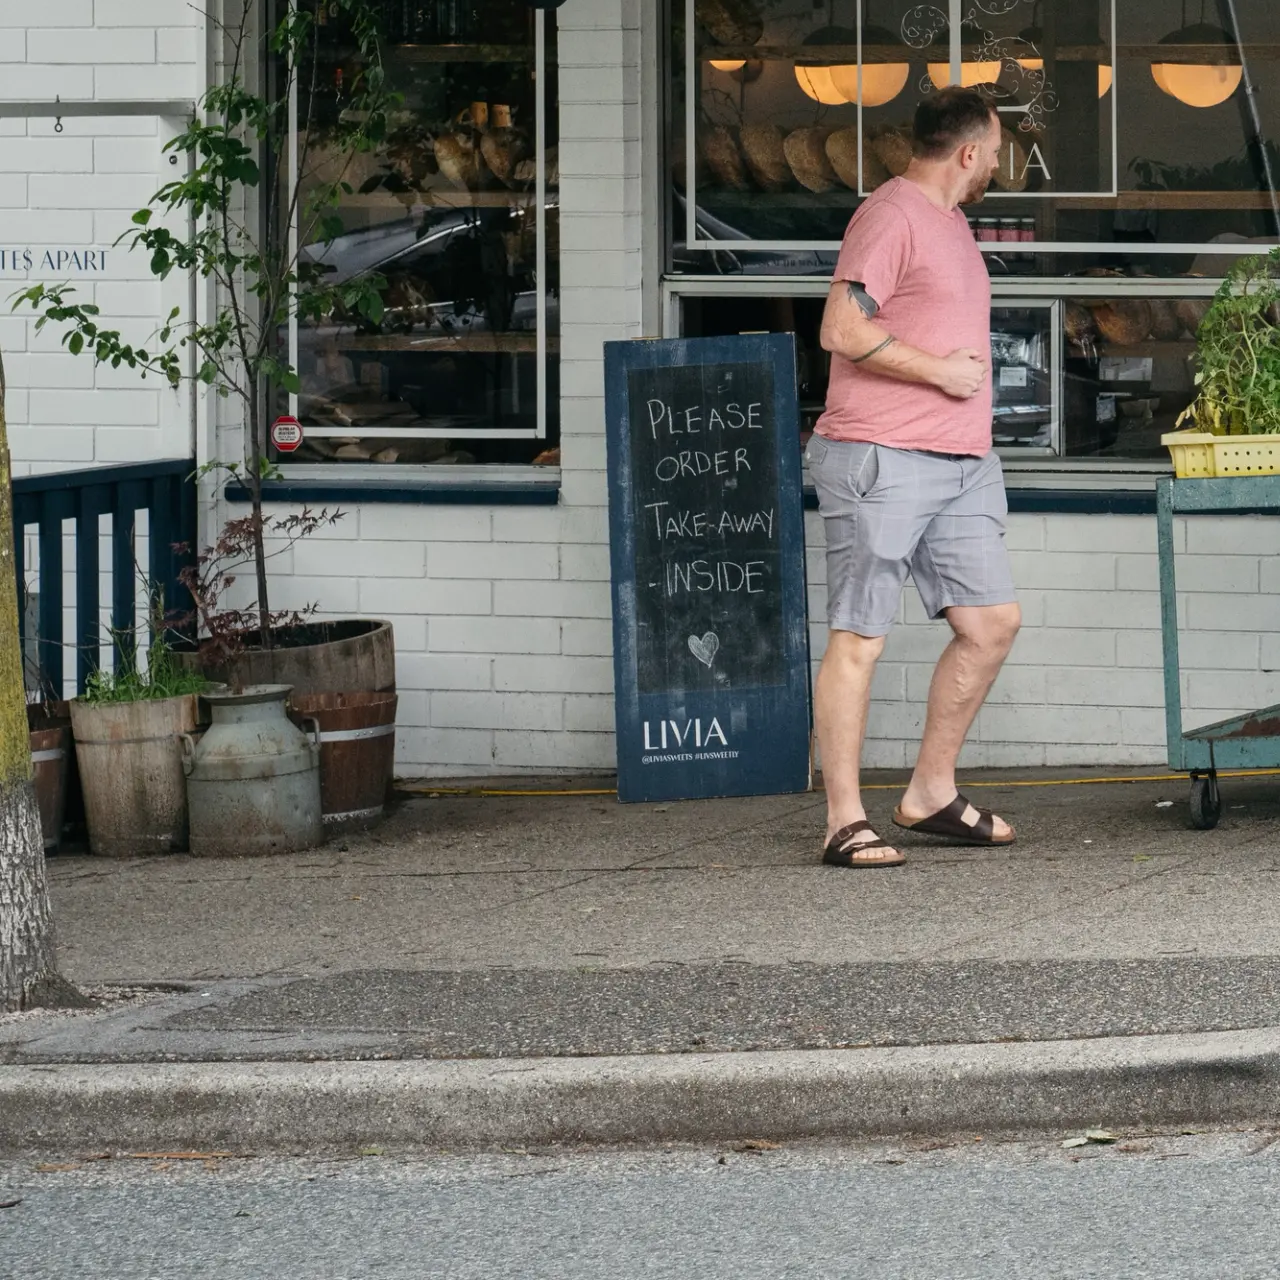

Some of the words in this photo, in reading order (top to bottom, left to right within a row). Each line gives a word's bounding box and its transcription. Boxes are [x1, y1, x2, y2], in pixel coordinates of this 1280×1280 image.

[40, 249, 110, 271] APART
[646, 398, 764, 440] PLEASE
[655, 447, 752, 481] ORDER
[665, 560, 765, 597] INSIDE
[643, 716, 728, 750] LIVIA
[641, 753, 694, 765] @LIVIASWEETS
[694, 750, 740, 762] #LIVSWEETLY
